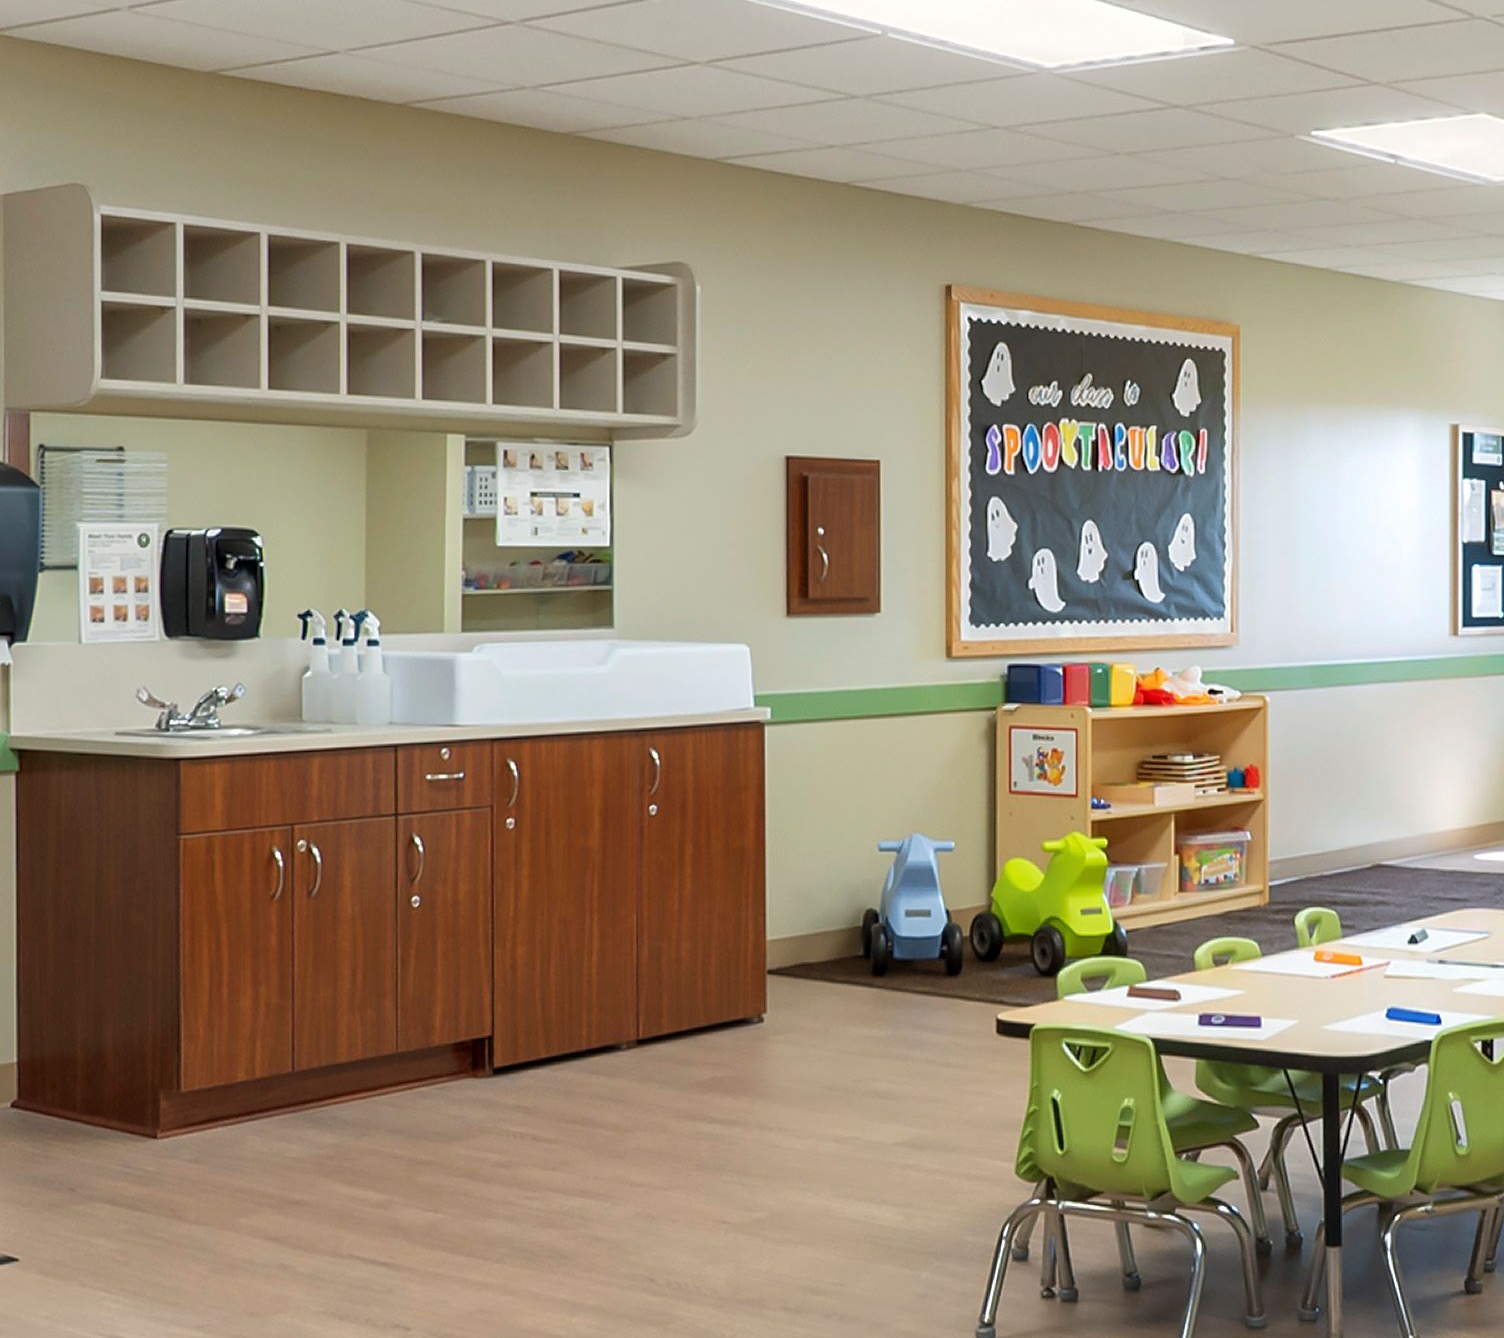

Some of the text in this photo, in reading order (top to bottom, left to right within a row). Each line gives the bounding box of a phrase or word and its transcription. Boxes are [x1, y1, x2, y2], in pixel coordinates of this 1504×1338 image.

[1028, 373, 1141, 409] our class is
[985, 418, 1208, 477] SPOOKTACULAR!
